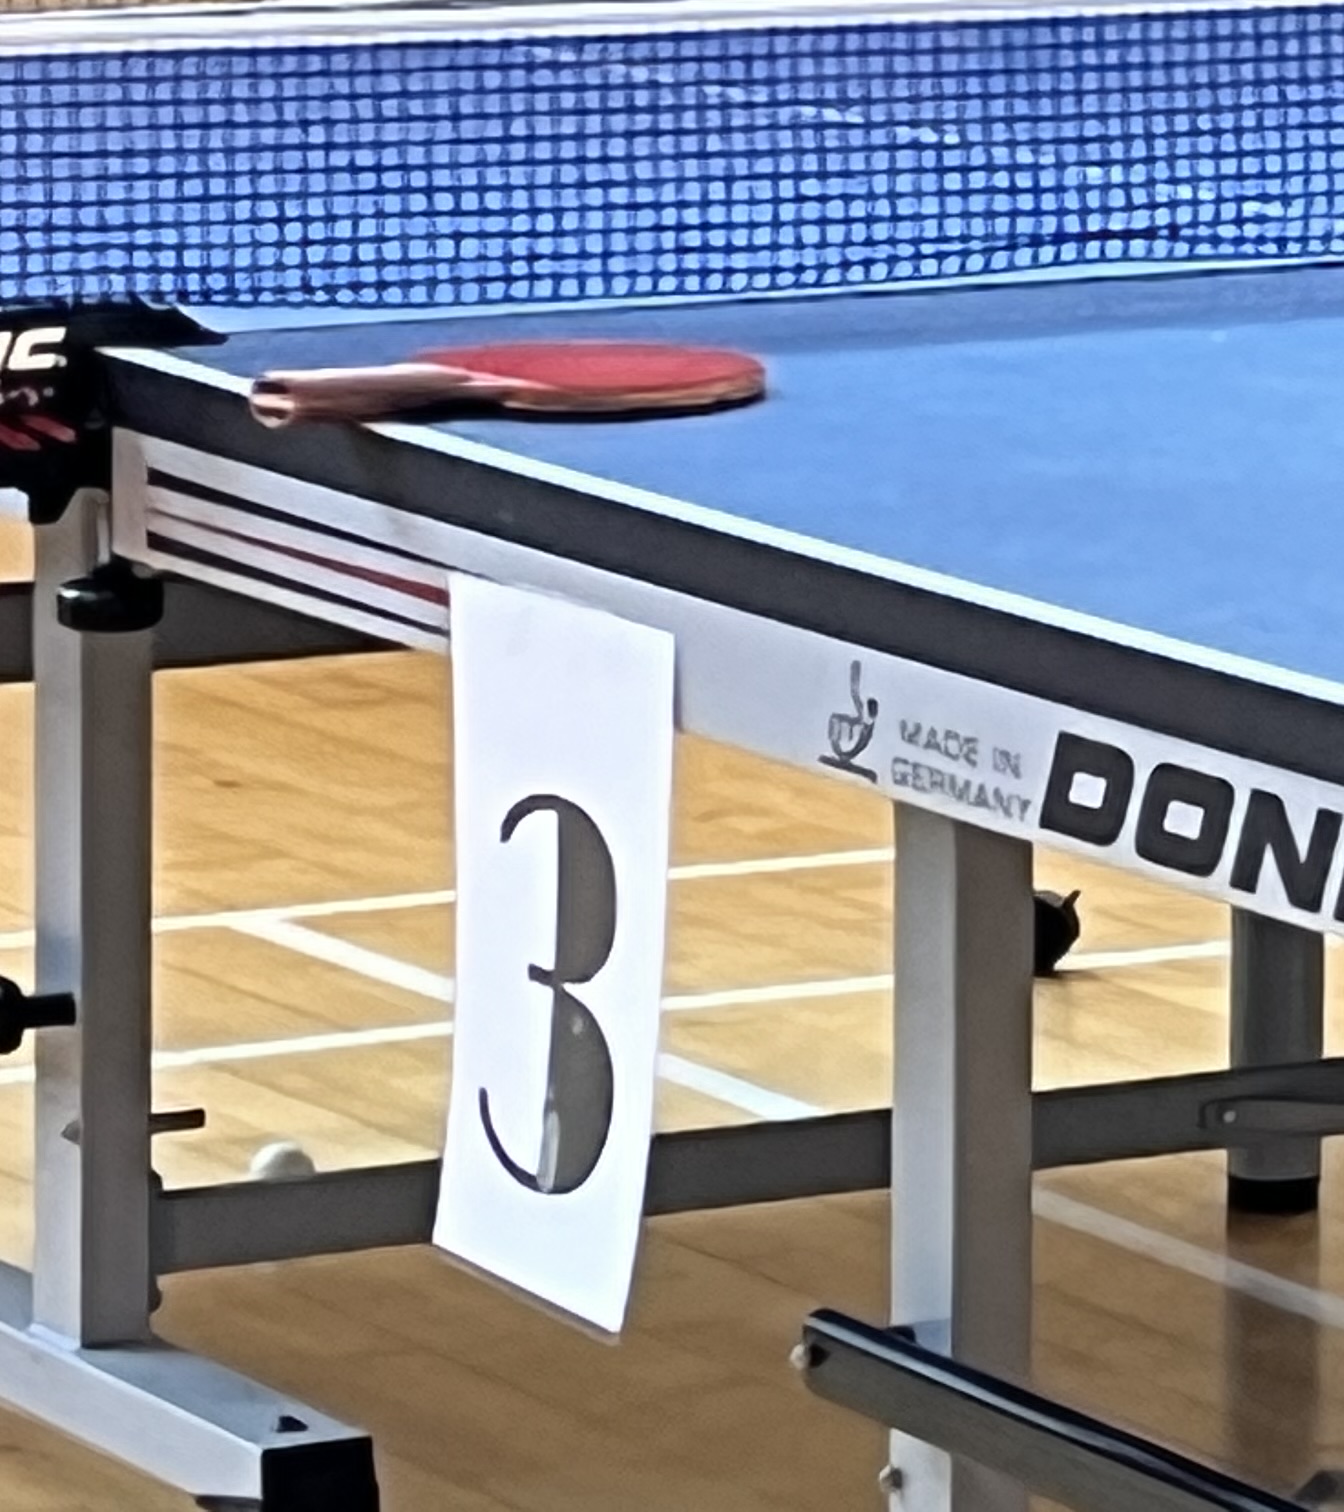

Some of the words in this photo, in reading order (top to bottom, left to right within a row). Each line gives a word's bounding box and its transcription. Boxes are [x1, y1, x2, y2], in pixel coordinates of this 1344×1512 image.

[898, 719, 979, 769] MADE
[992, 746, 1022, 780] IN
[890, 755, 1032, 822] GERMANY
[480, 793, 617, 1195] 3
